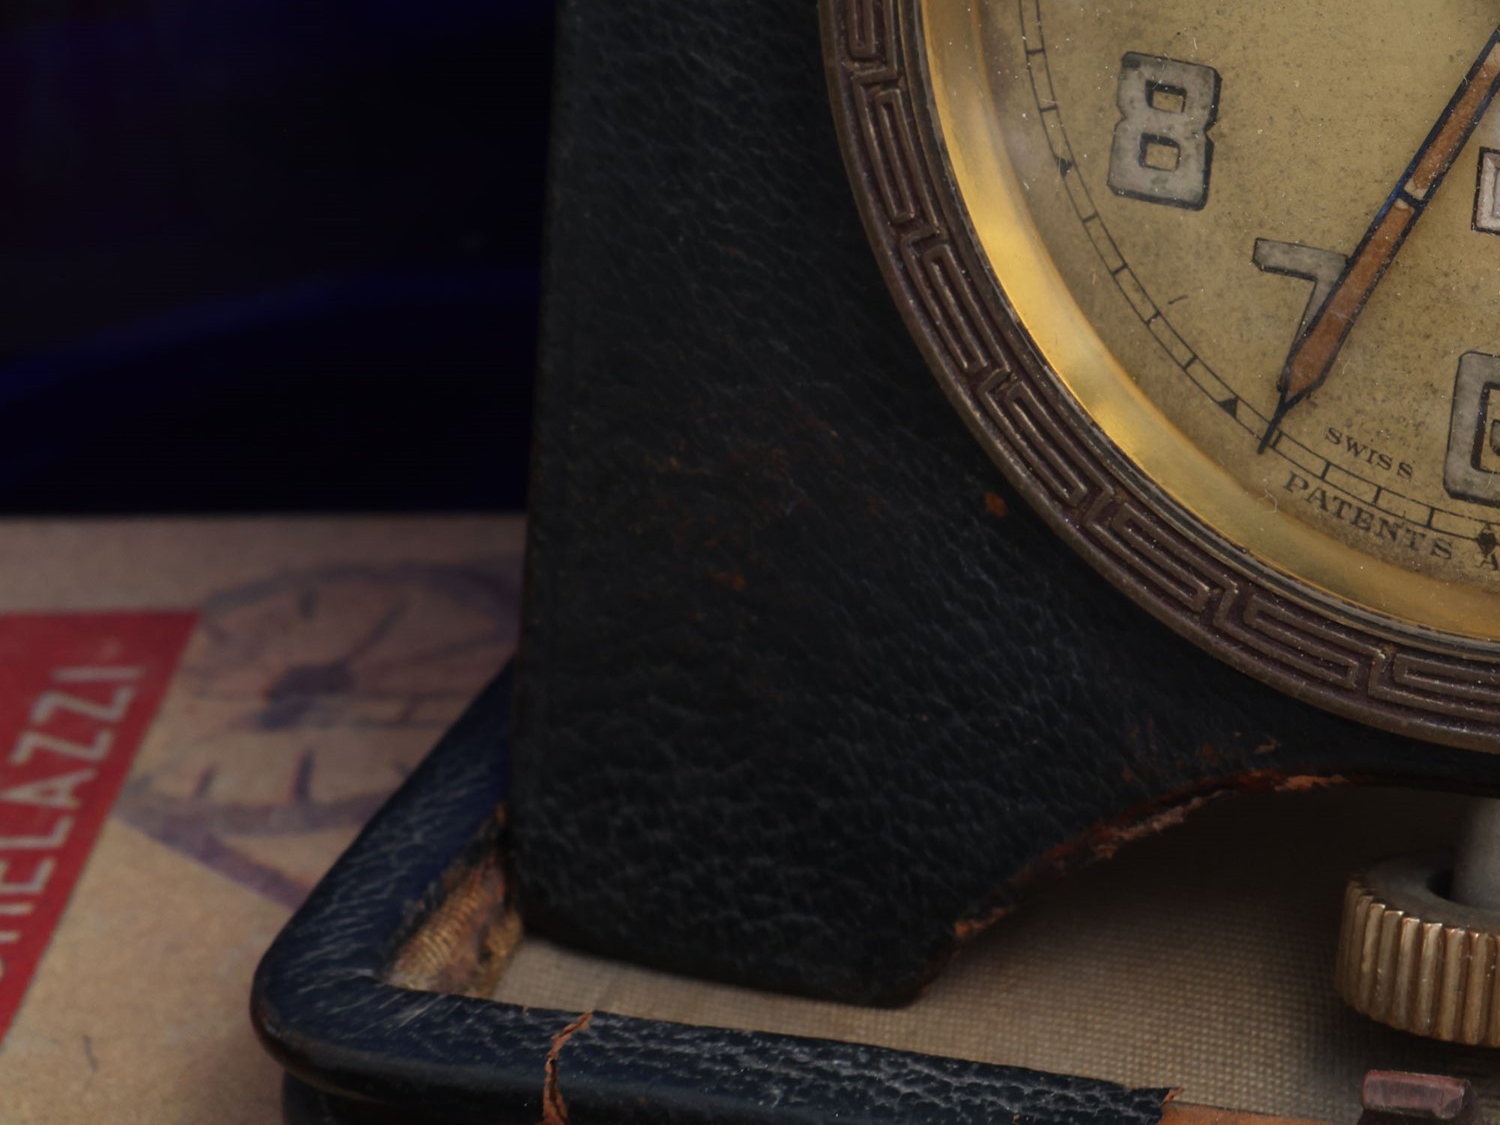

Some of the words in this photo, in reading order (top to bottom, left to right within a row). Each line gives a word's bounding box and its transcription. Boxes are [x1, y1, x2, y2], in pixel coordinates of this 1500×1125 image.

[1106, 50, 1223, 211] 8
[1324, 426, 1414, 482] SWISS
[1283, 470, 1454, 561] PATENTS
